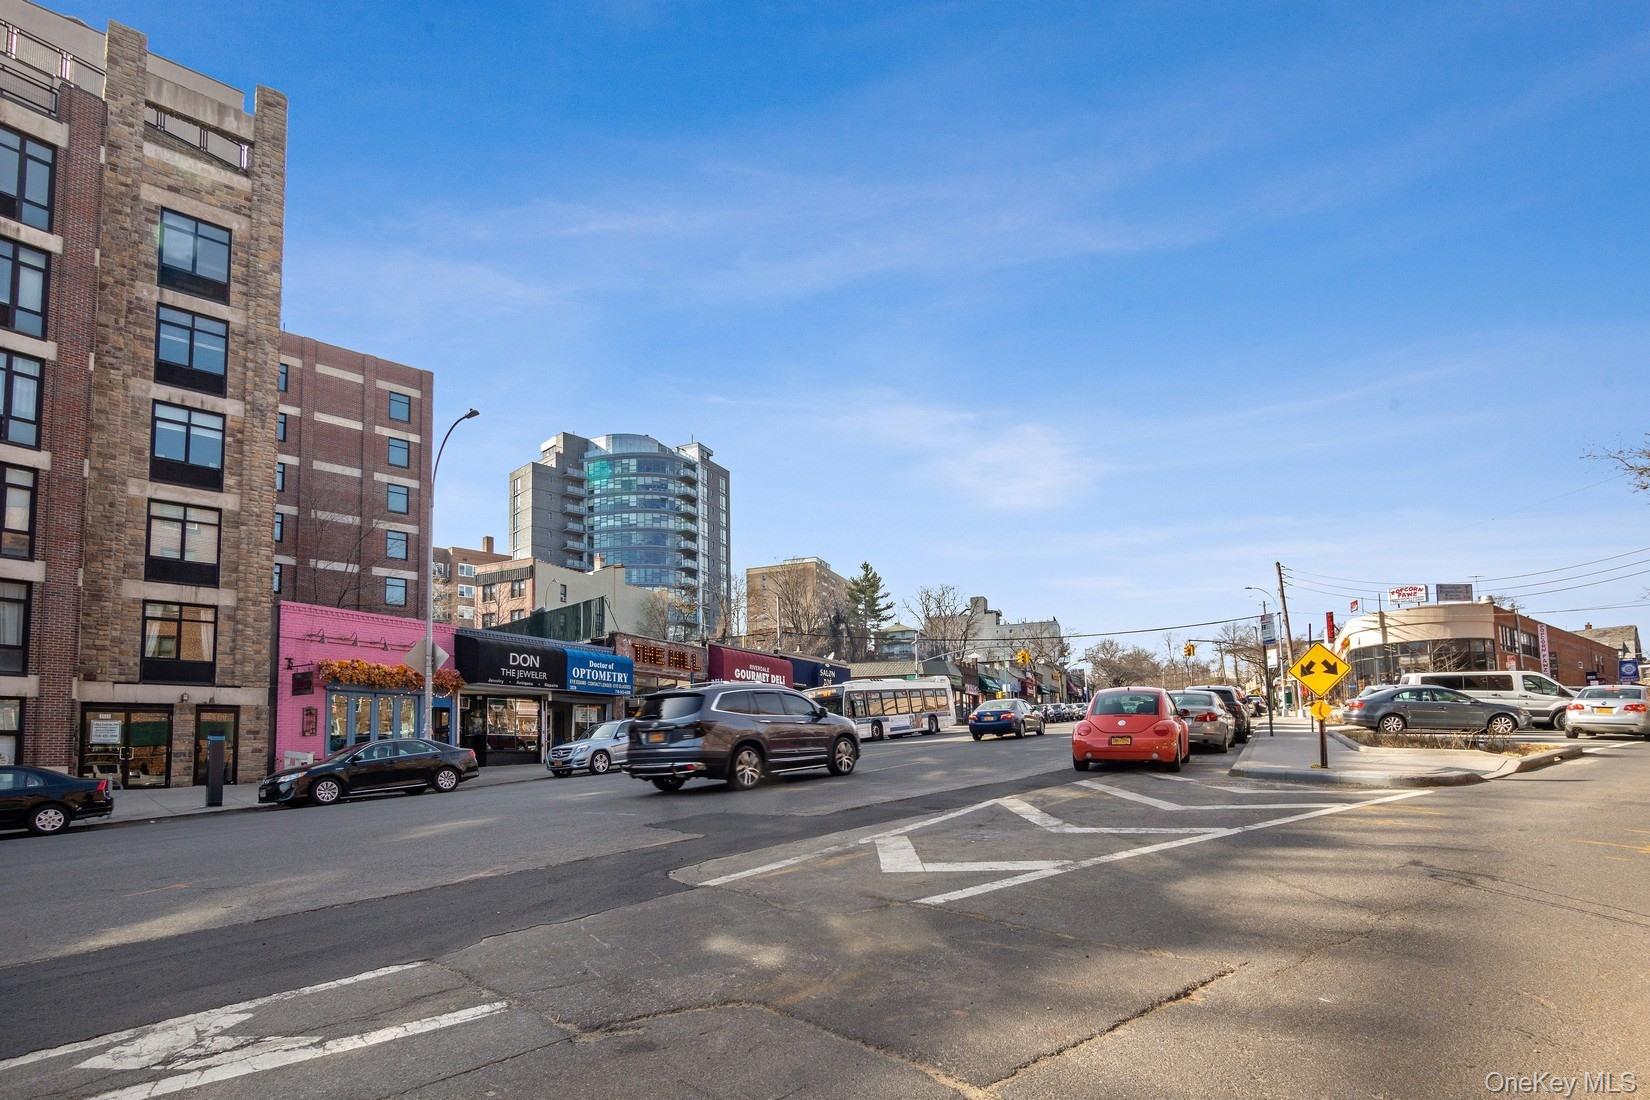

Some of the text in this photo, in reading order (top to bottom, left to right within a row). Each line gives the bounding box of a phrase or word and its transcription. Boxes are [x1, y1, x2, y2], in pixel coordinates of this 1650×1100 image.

[1390, 586, 1424, 596] POPCORN
[509, 652, 540, 668] DON
[632, 643, 701, 671] THE HILL
[589, 660, 614, 670] Doctor of
[749, 664, 770, 673] RIVERDALE
[500, 667, 547, 680] THE JEWELER
[572, 667, 628, 683] OPTOMETRY
[734, 668, 786, 685] GOURMET DELI
[819, 668, 836, 678] SALON
